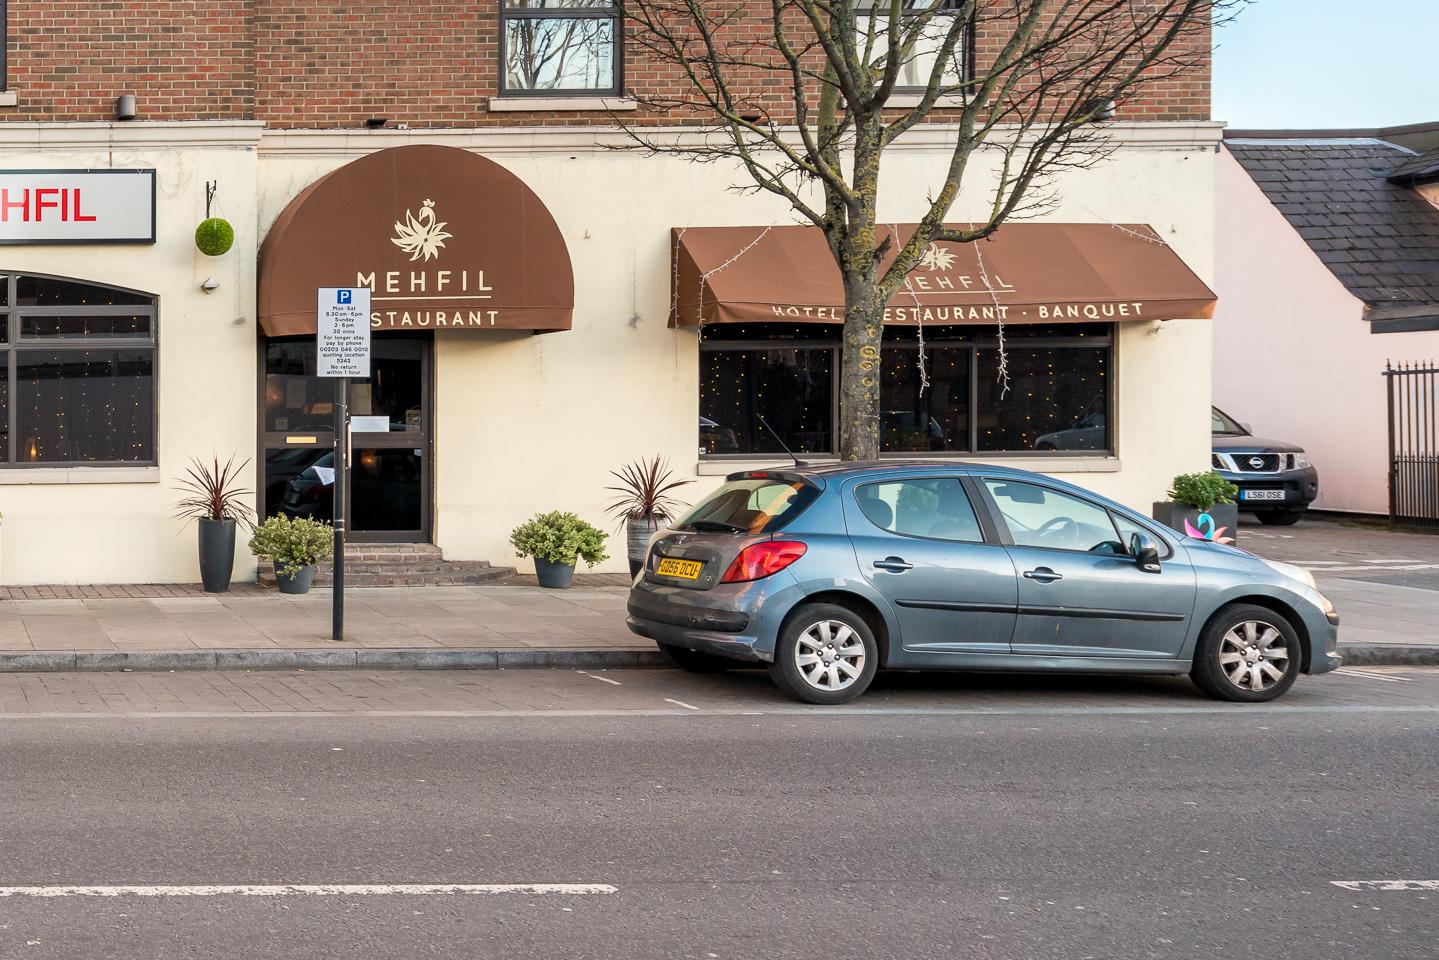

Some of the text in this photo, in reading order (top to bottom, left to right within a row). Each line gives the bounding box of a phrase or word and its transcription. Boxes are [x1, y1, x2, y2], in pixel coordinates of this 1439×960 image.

[356, 270, 493, 293] MEHFIL
[340, 291, 350, 303] P
[370, 310, 499, 327] STAURANT
[772, 302, 1144, 321] HOTEL ESTAURANT BANQUET
